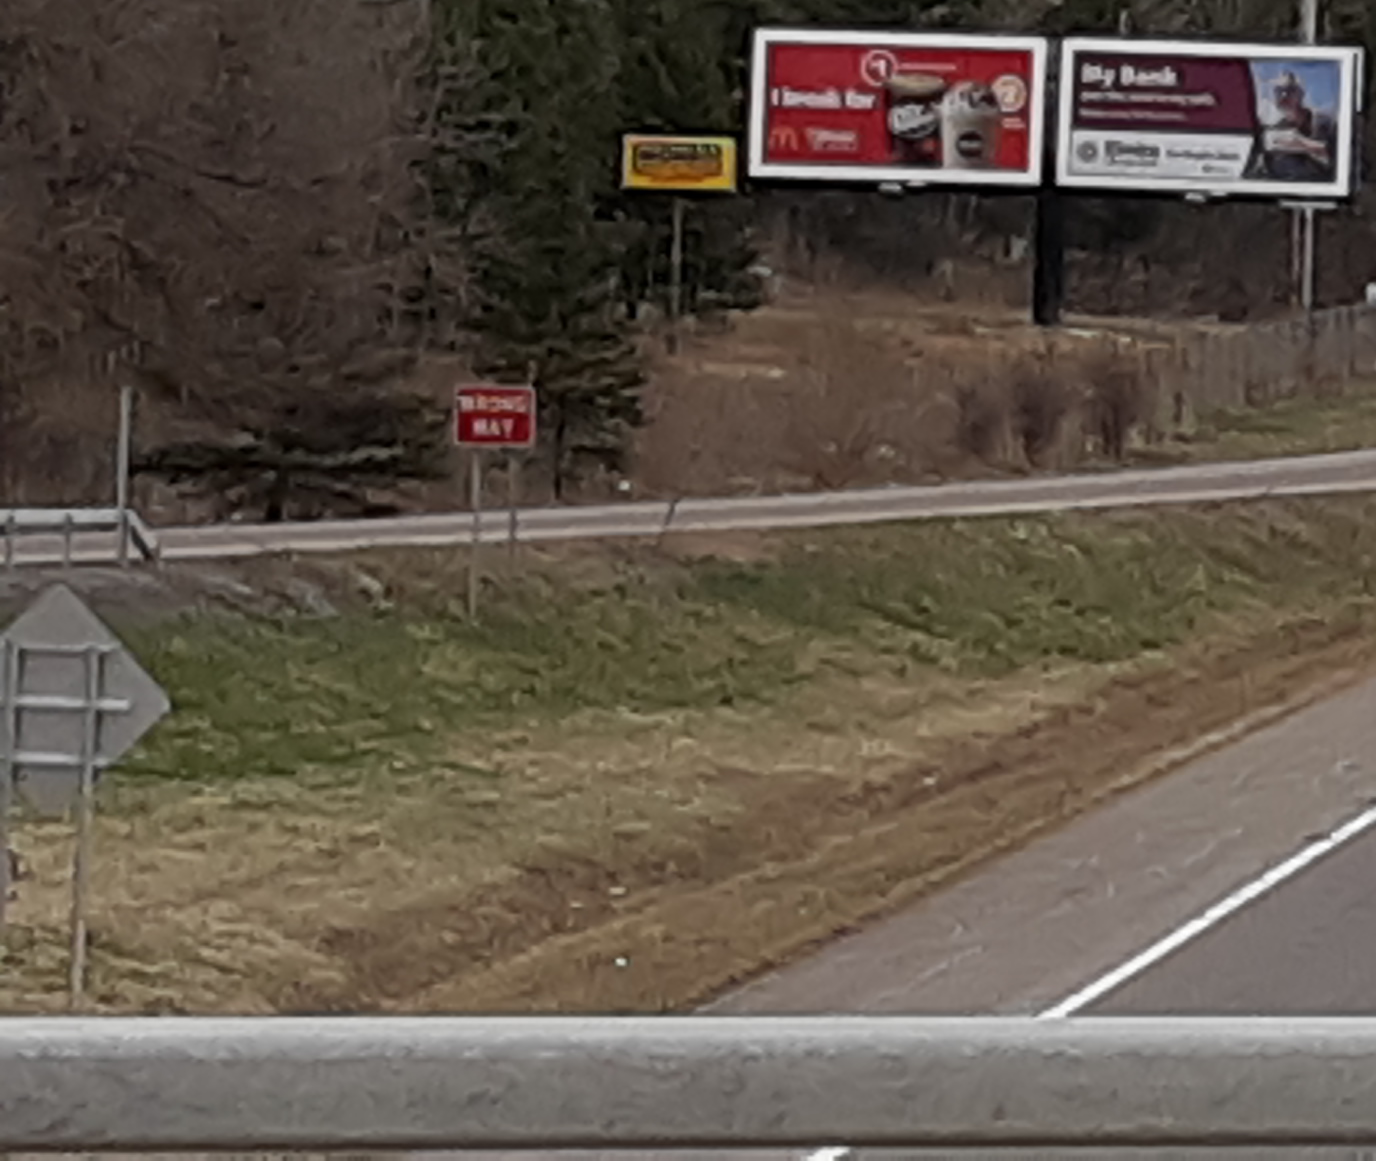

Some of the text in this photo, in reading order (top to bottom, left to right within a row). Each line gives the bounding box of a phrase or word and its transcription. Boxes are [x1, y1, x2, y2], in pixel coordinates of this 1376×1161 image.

[1081, 63, 1177, 88] My Bank
[458, 395, 527, 413] WRONG
[472, 418, 515, 438] WAY
